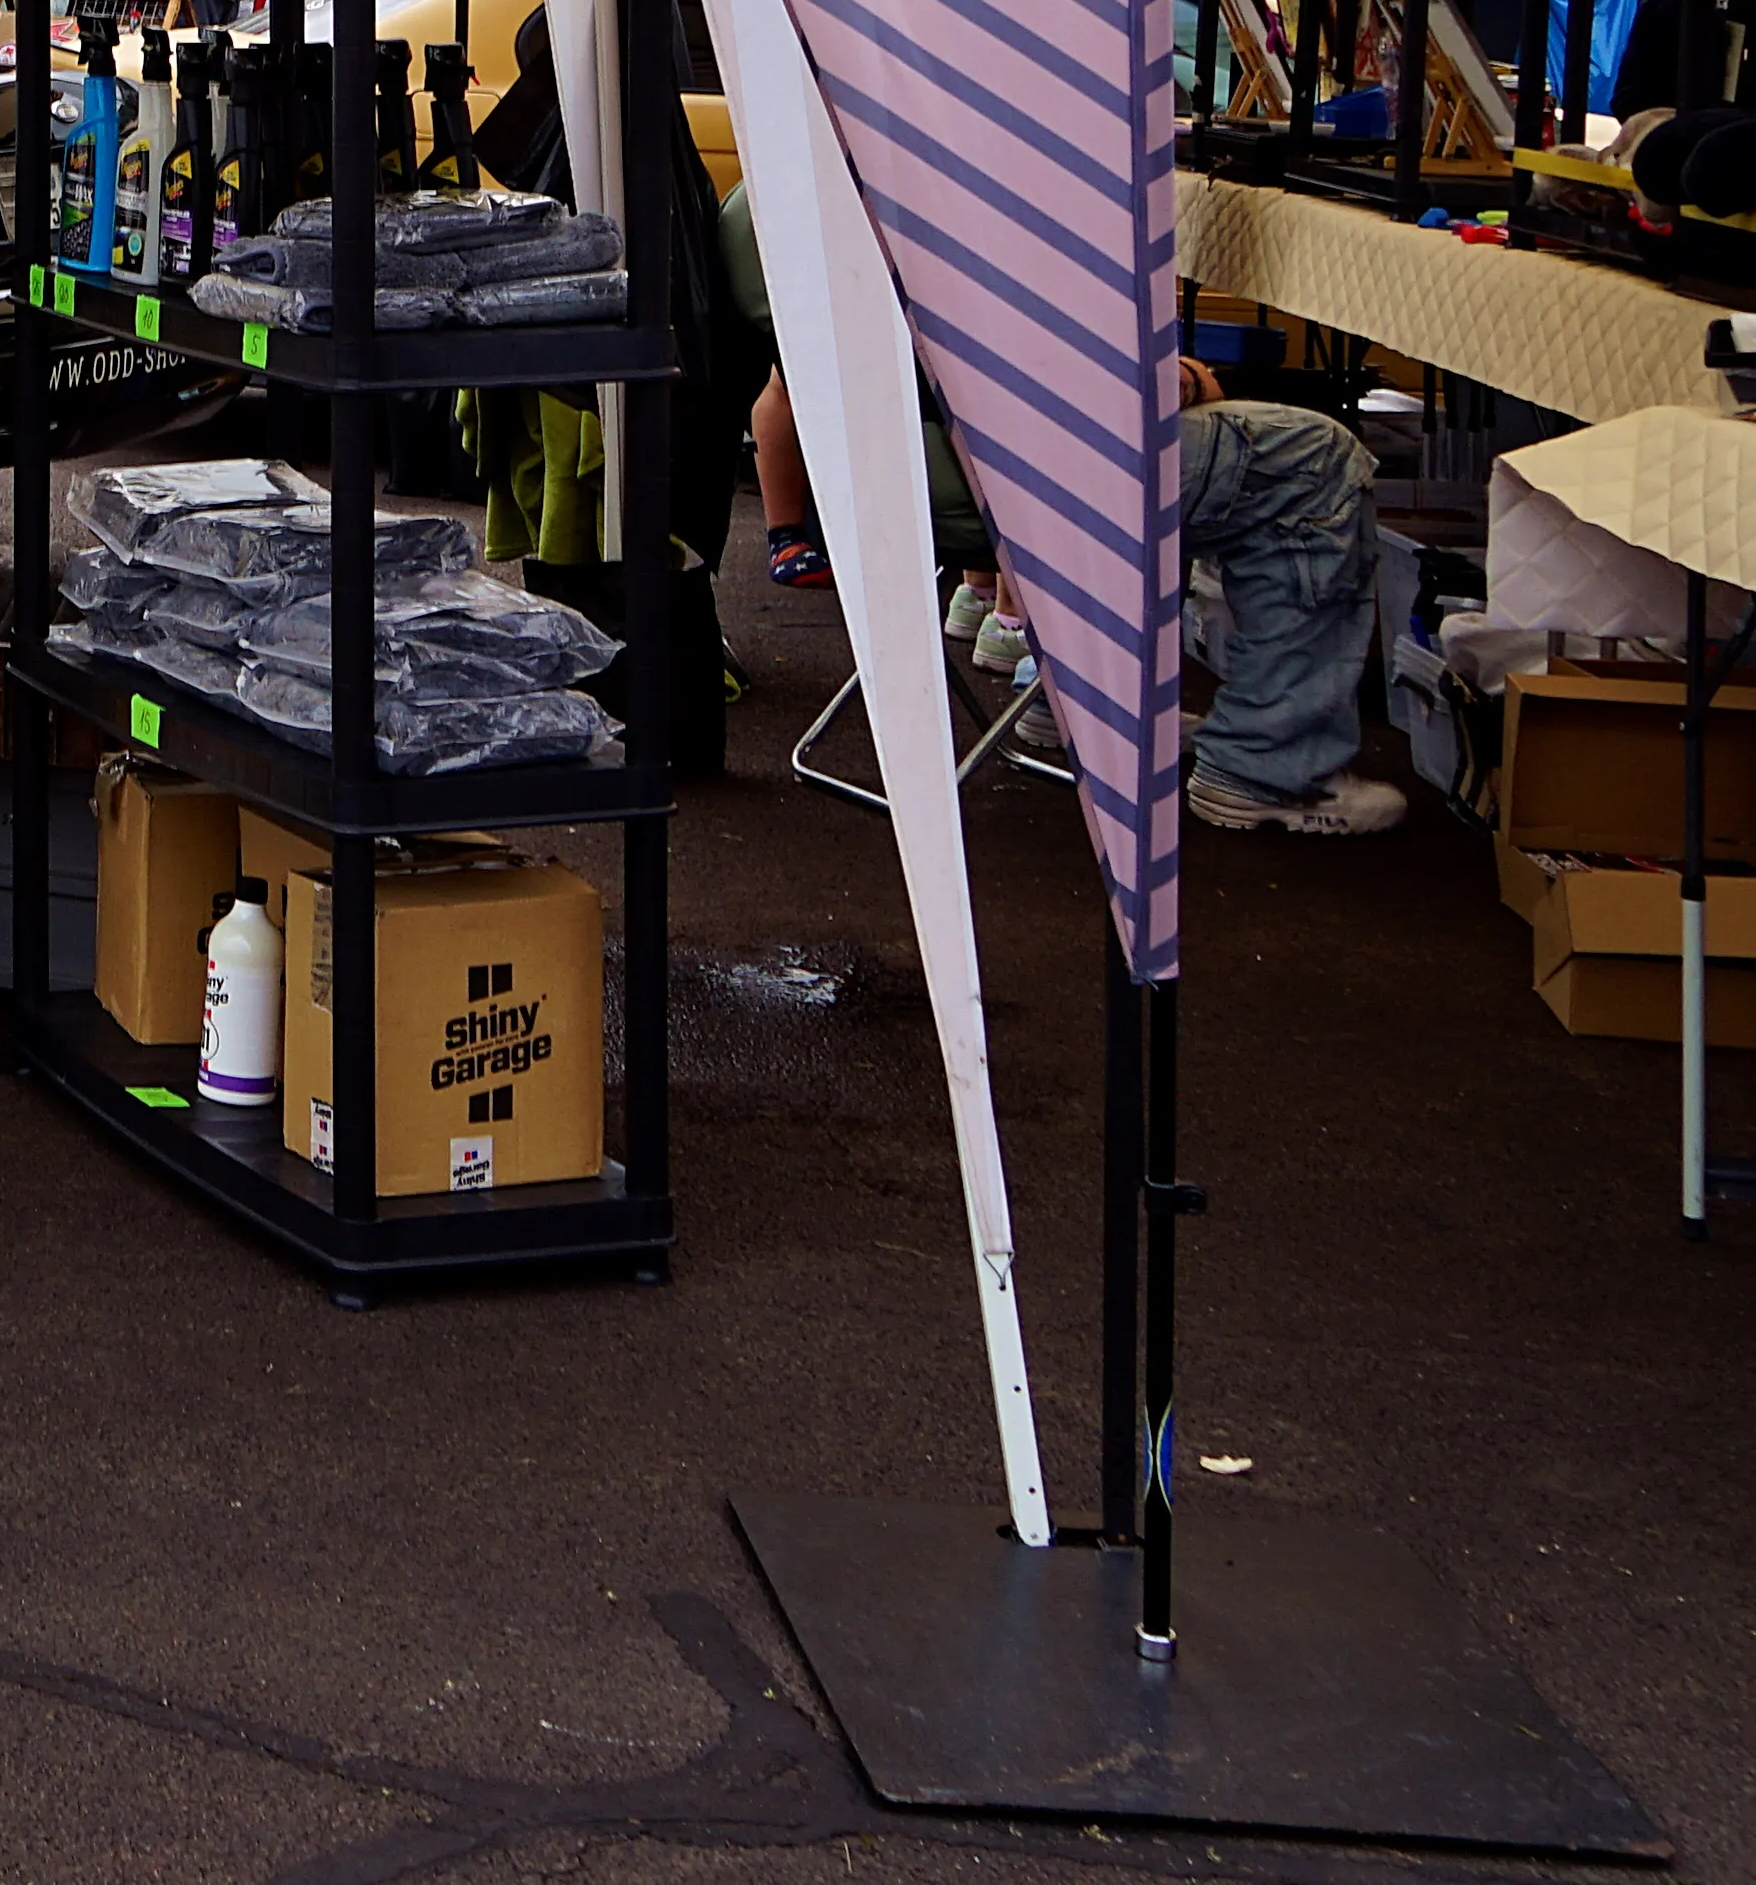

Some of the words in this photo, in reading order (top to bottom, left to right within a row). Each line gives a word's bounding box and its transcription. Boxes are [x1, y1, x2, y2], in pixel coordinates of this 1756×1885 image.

[142, 309, 153, 330] 10
[251, 336, 261, 355] 5
[139, 707, 151, 735] 15
[445, 1002, 540, 1051] Shiny
[430, 1033, 552, 1091] Garage
